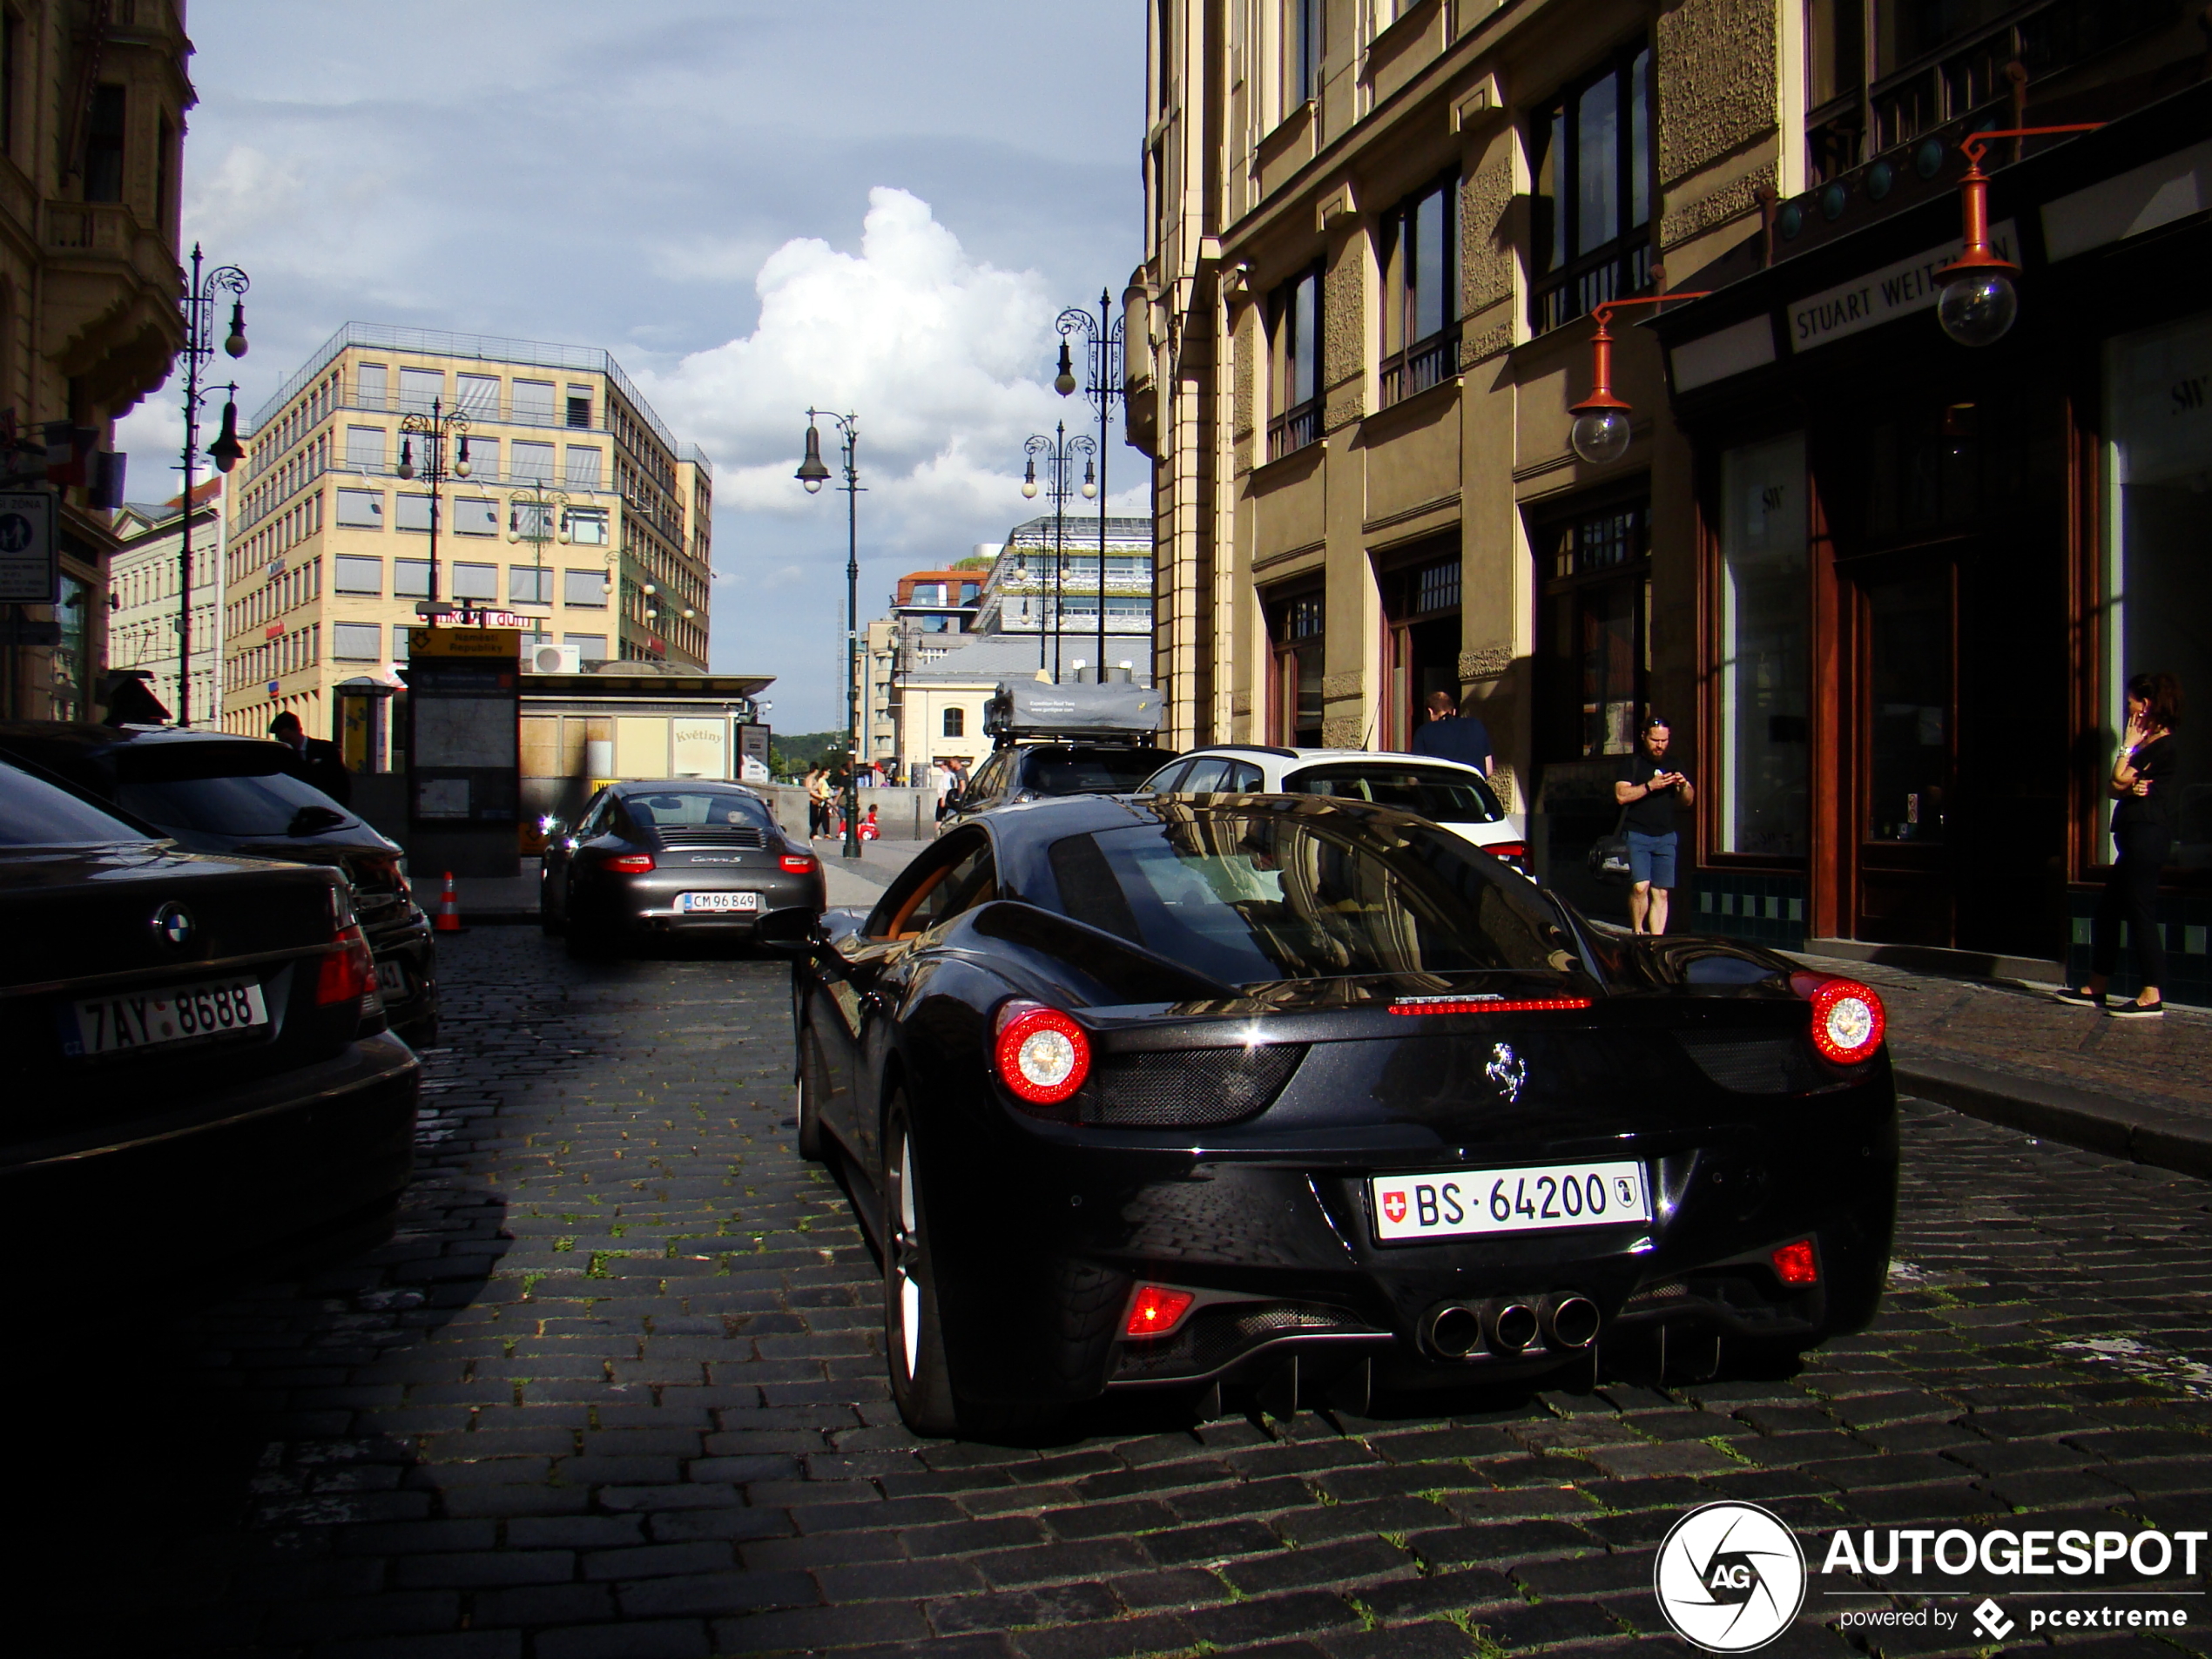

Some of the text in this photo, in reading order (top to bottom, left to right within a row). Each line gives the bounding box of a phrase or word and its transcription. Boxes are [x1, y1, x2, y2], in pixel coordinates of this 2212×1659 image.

[1797, 237, 2009, 339] STUART WEITN
[448, 643, 503, 653] Republiky
[676, 730, 724, 745] Květiny
[694, 895, 711, 907] CM
[732, 895, 754, 907] 849
[84, 996, 150, 1051] 7AY
[175, 982, 253, 1035] 8688
[64, 1041, 84, 1056] CZ
